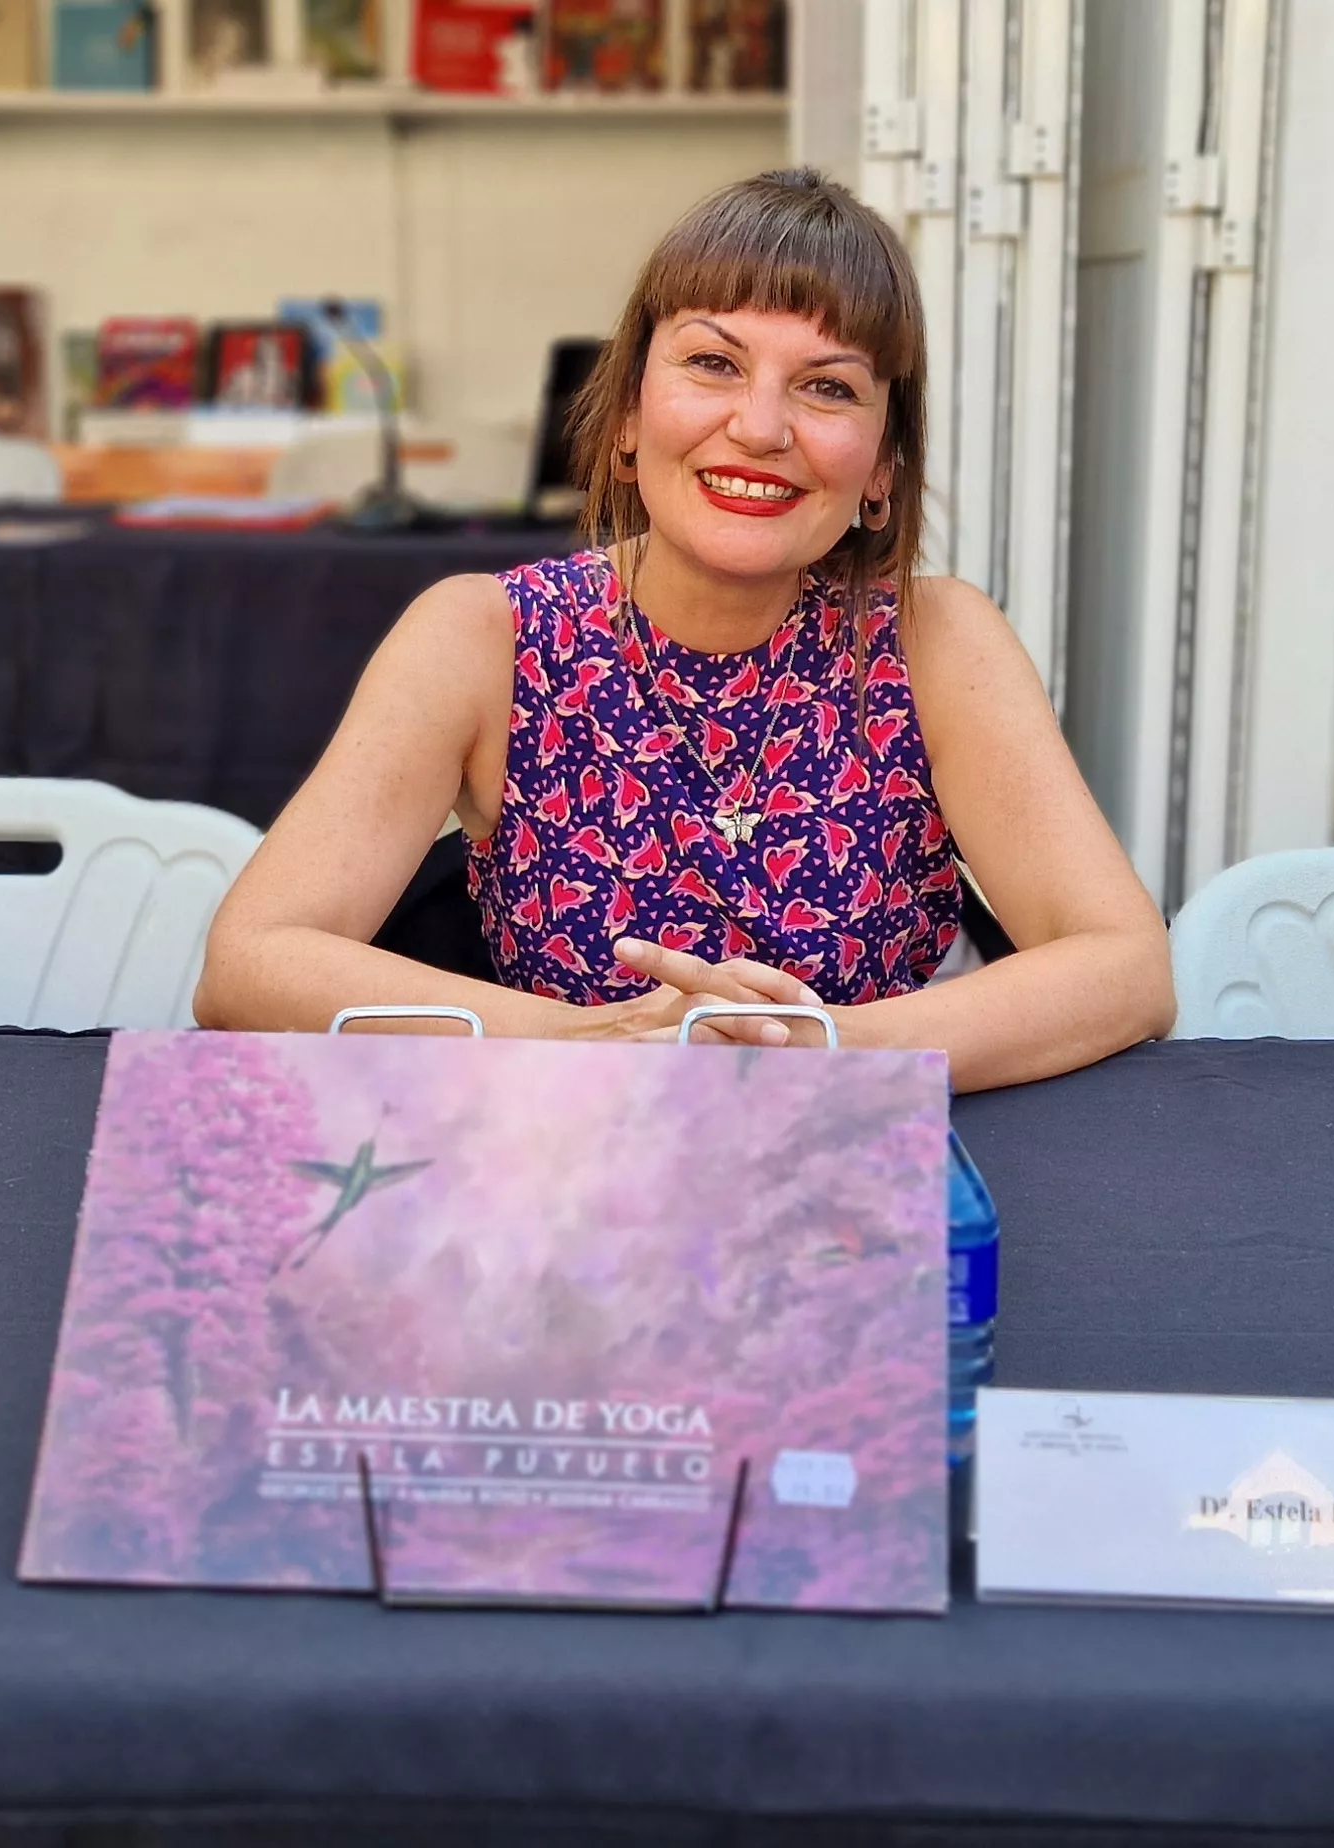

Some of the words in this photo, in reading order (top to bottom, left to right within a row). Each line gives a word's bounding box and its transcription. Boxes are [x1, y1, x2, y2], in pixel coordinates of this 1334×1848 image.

[276, 1387, 323, 1423] LA
[334, 1394, 520, 1431] MAESTRA
[533, 1398, 589, 1432] DE
[596, 1400, 712, 1437] YOGA
[484, 1446, 711, 1481] PUYUELO
[1245, 1497, 1322, 1524] Estela
